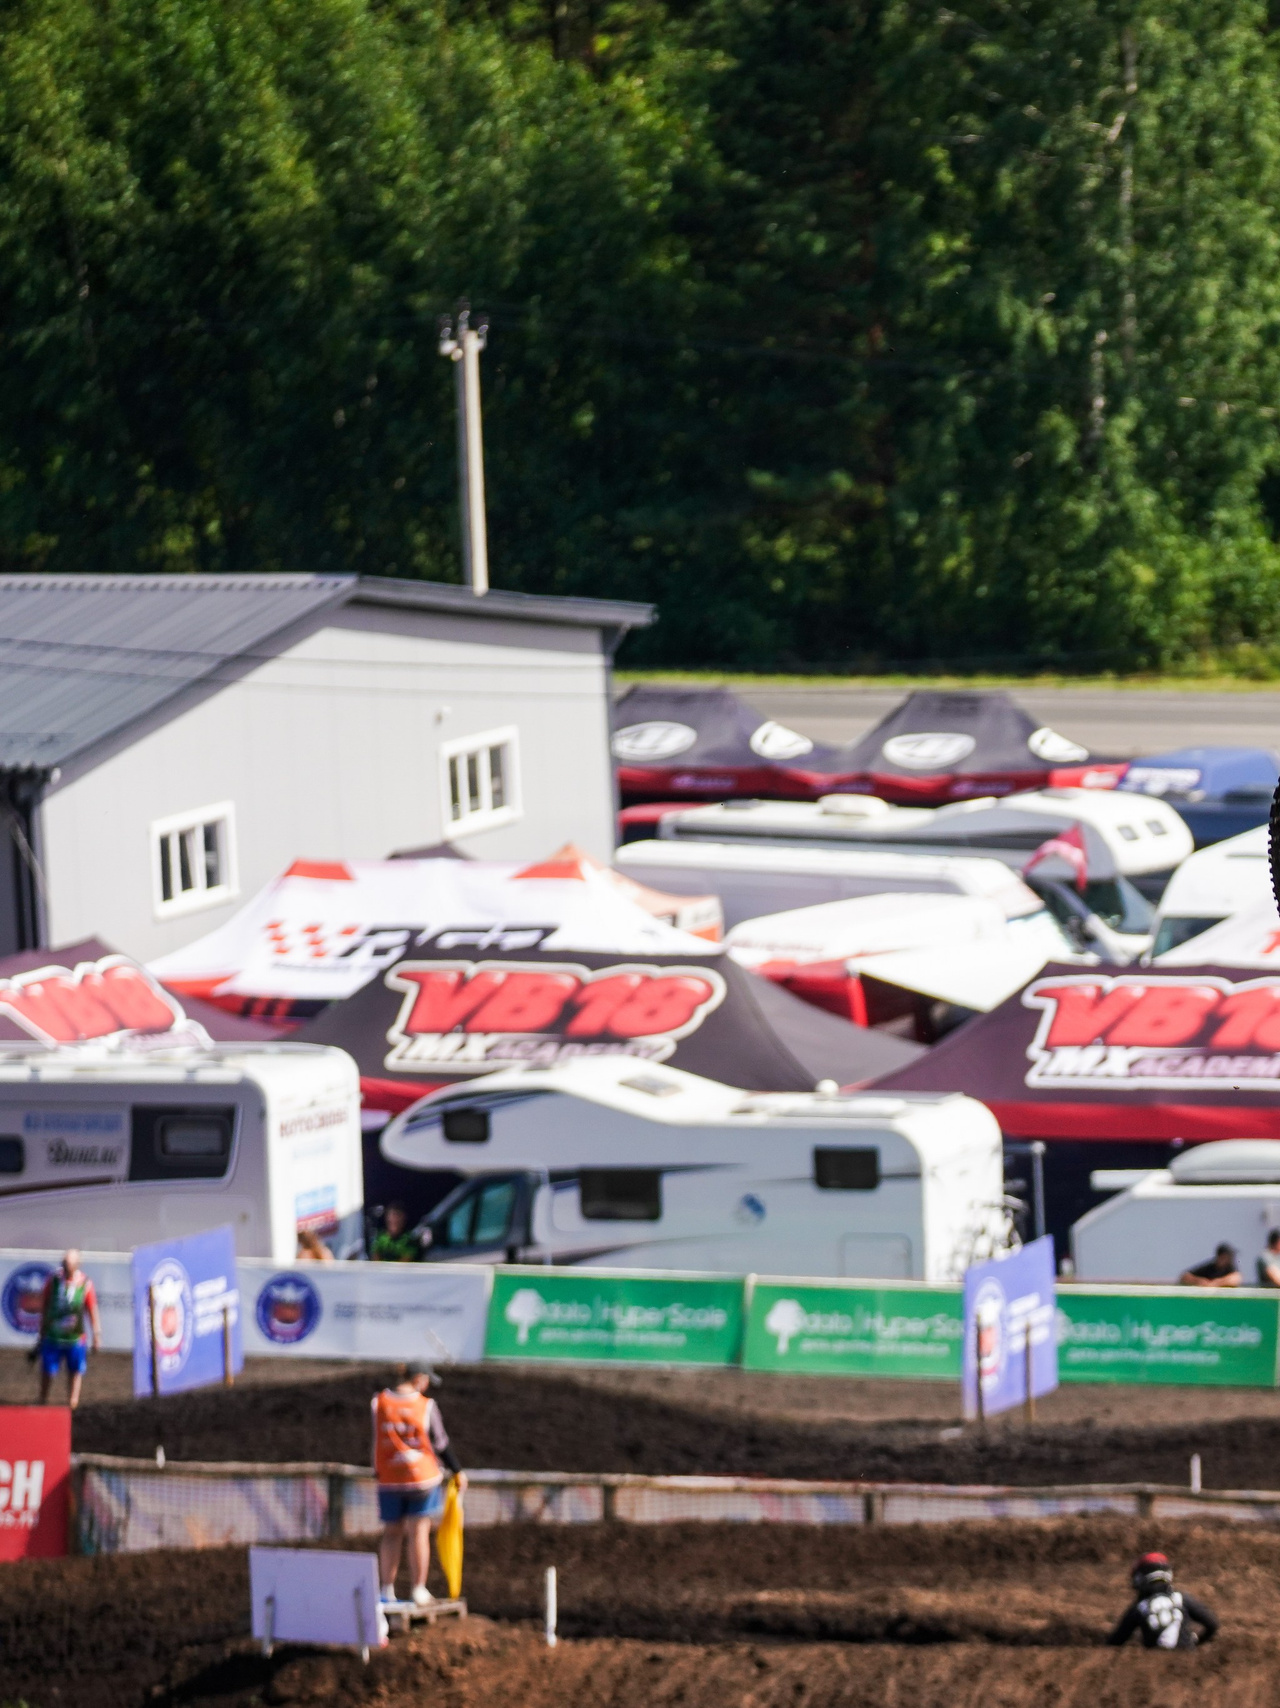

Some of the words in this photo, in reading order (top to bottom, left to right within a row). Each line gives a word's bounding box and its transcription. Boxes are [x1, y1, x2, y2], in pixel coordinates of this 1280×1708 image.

[396, 970, 714, 1039] VB18
[402, 1032, 497, 1062] MX
[1040, 1046, 1137, 1078] MX
[864, 1311, 964, 1340] HyperSc
